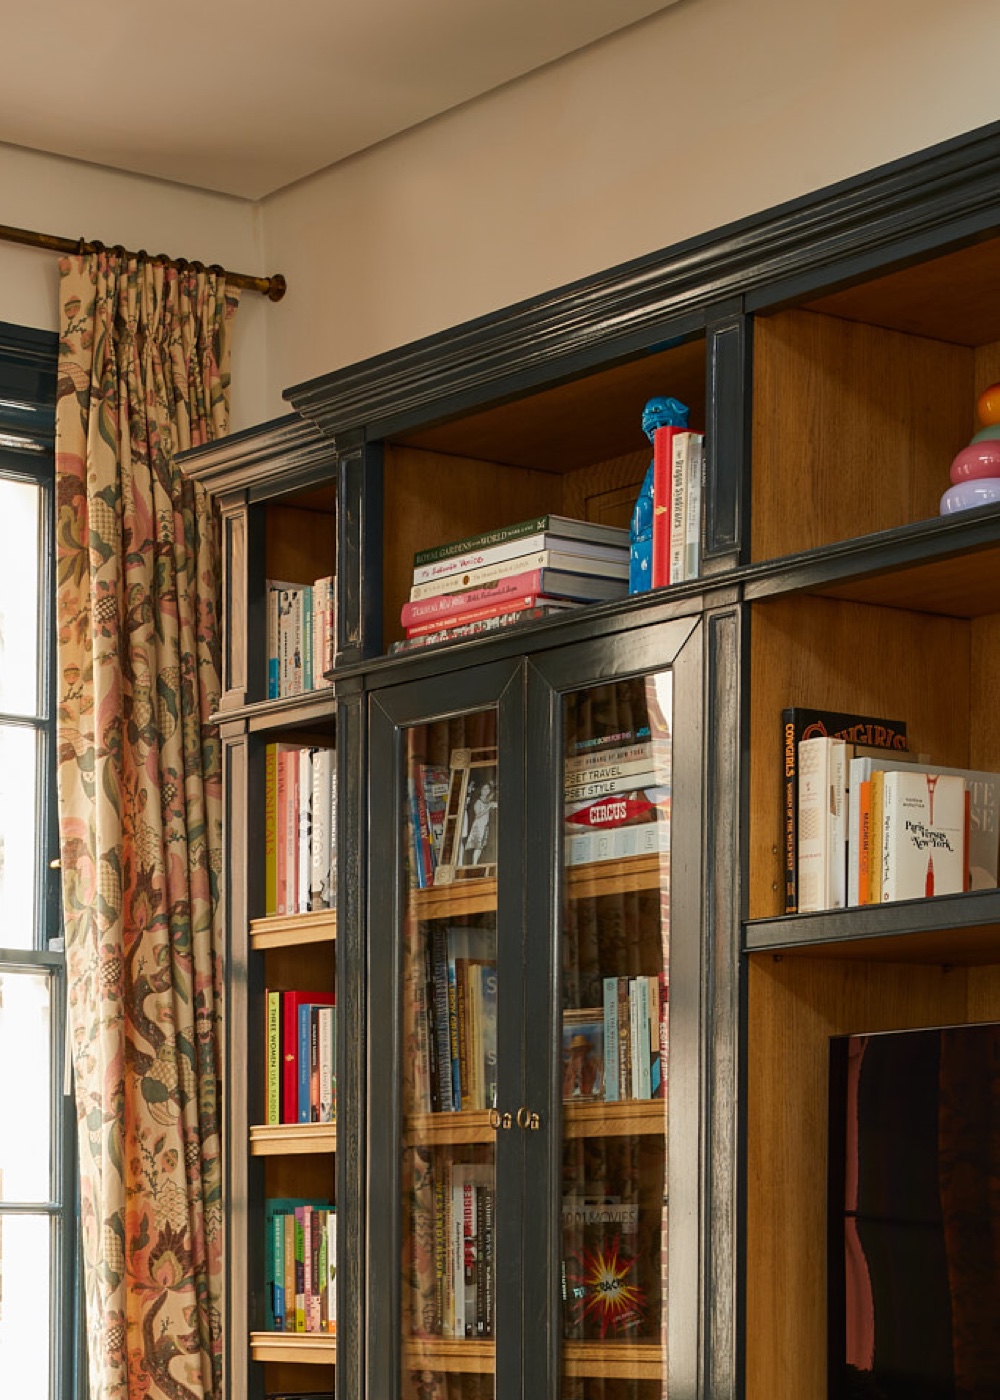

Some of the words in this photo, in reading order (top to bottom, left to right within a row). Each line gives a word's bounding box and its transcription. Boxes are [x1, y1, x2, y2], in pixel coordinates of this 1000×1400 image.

[439, 542, 472, 557] GARDENS
[785, 723, 795, 778] COWGIRLS
[589, 765, 623, 780] TRAVEL
[587, 781, 616, 796] STYLE
[266, 753, 275, 856] BOTANICALS
[589, 801, 627, 825] CIRCUS
[905, 819, 924, 835] Paris
[435, 1181, 443, 1208] WES
[435, 1212, 443, 1279] ANDERSON
